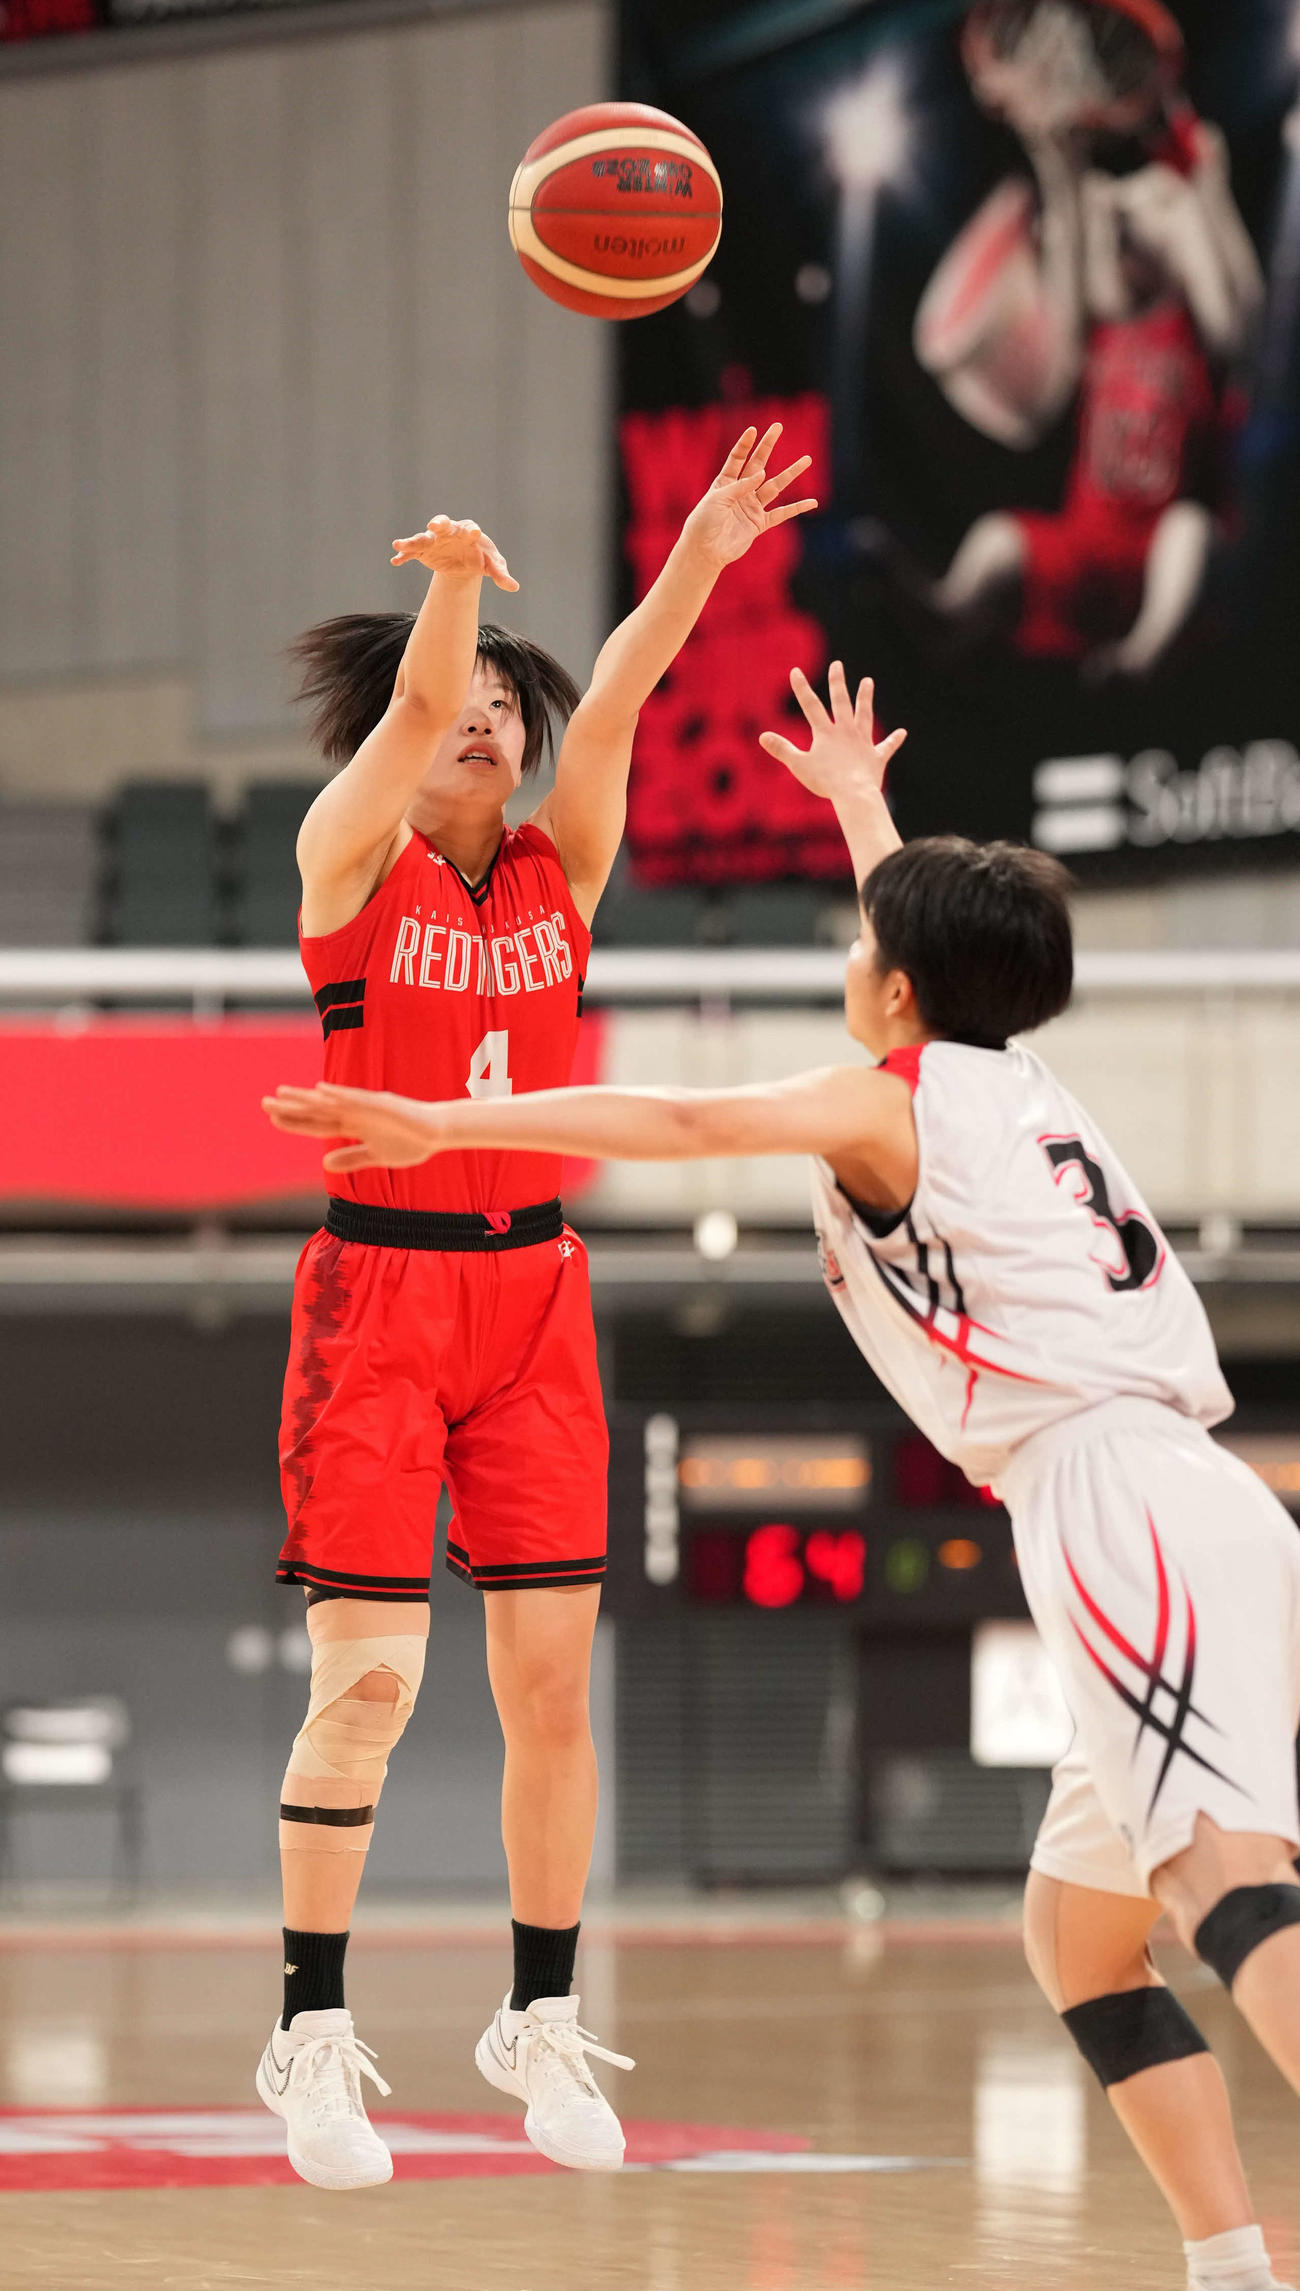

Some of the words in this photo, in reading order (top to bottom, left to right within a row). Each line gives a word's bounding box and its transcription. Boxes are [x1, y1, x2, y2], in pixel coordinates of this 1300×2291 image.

[617, 177, 692, 198] WINTER
[594, 235, 685, 258] molten
[465, 1029, 513, 1099] 4
[1037, 1133, 1167, 1293] 3
